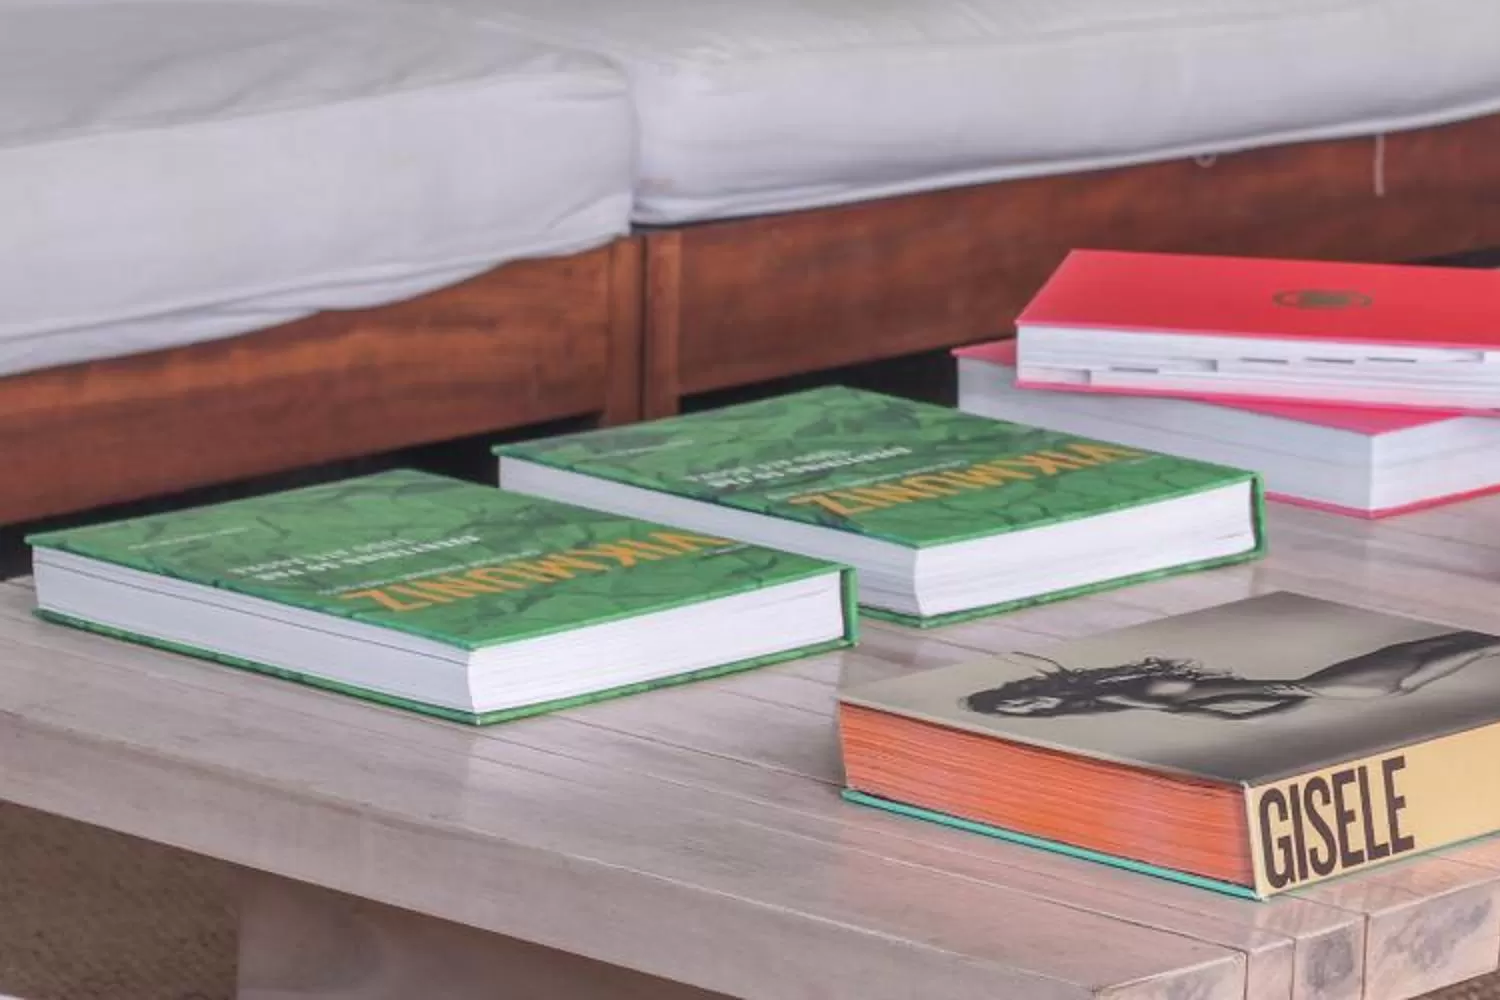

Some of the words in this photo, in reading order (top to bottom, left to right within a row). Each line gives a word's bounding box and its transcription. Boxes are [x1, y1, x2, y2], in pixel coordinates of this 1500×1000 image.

[990, 443, 1148, 475] VIK
[788, 464, 1037, 517] MUNIZ
[567, 531, 738, 568] VIK
[340, 552, 610, 612] MUNIZ
[1259, 755, 1415, 889] GISELE
